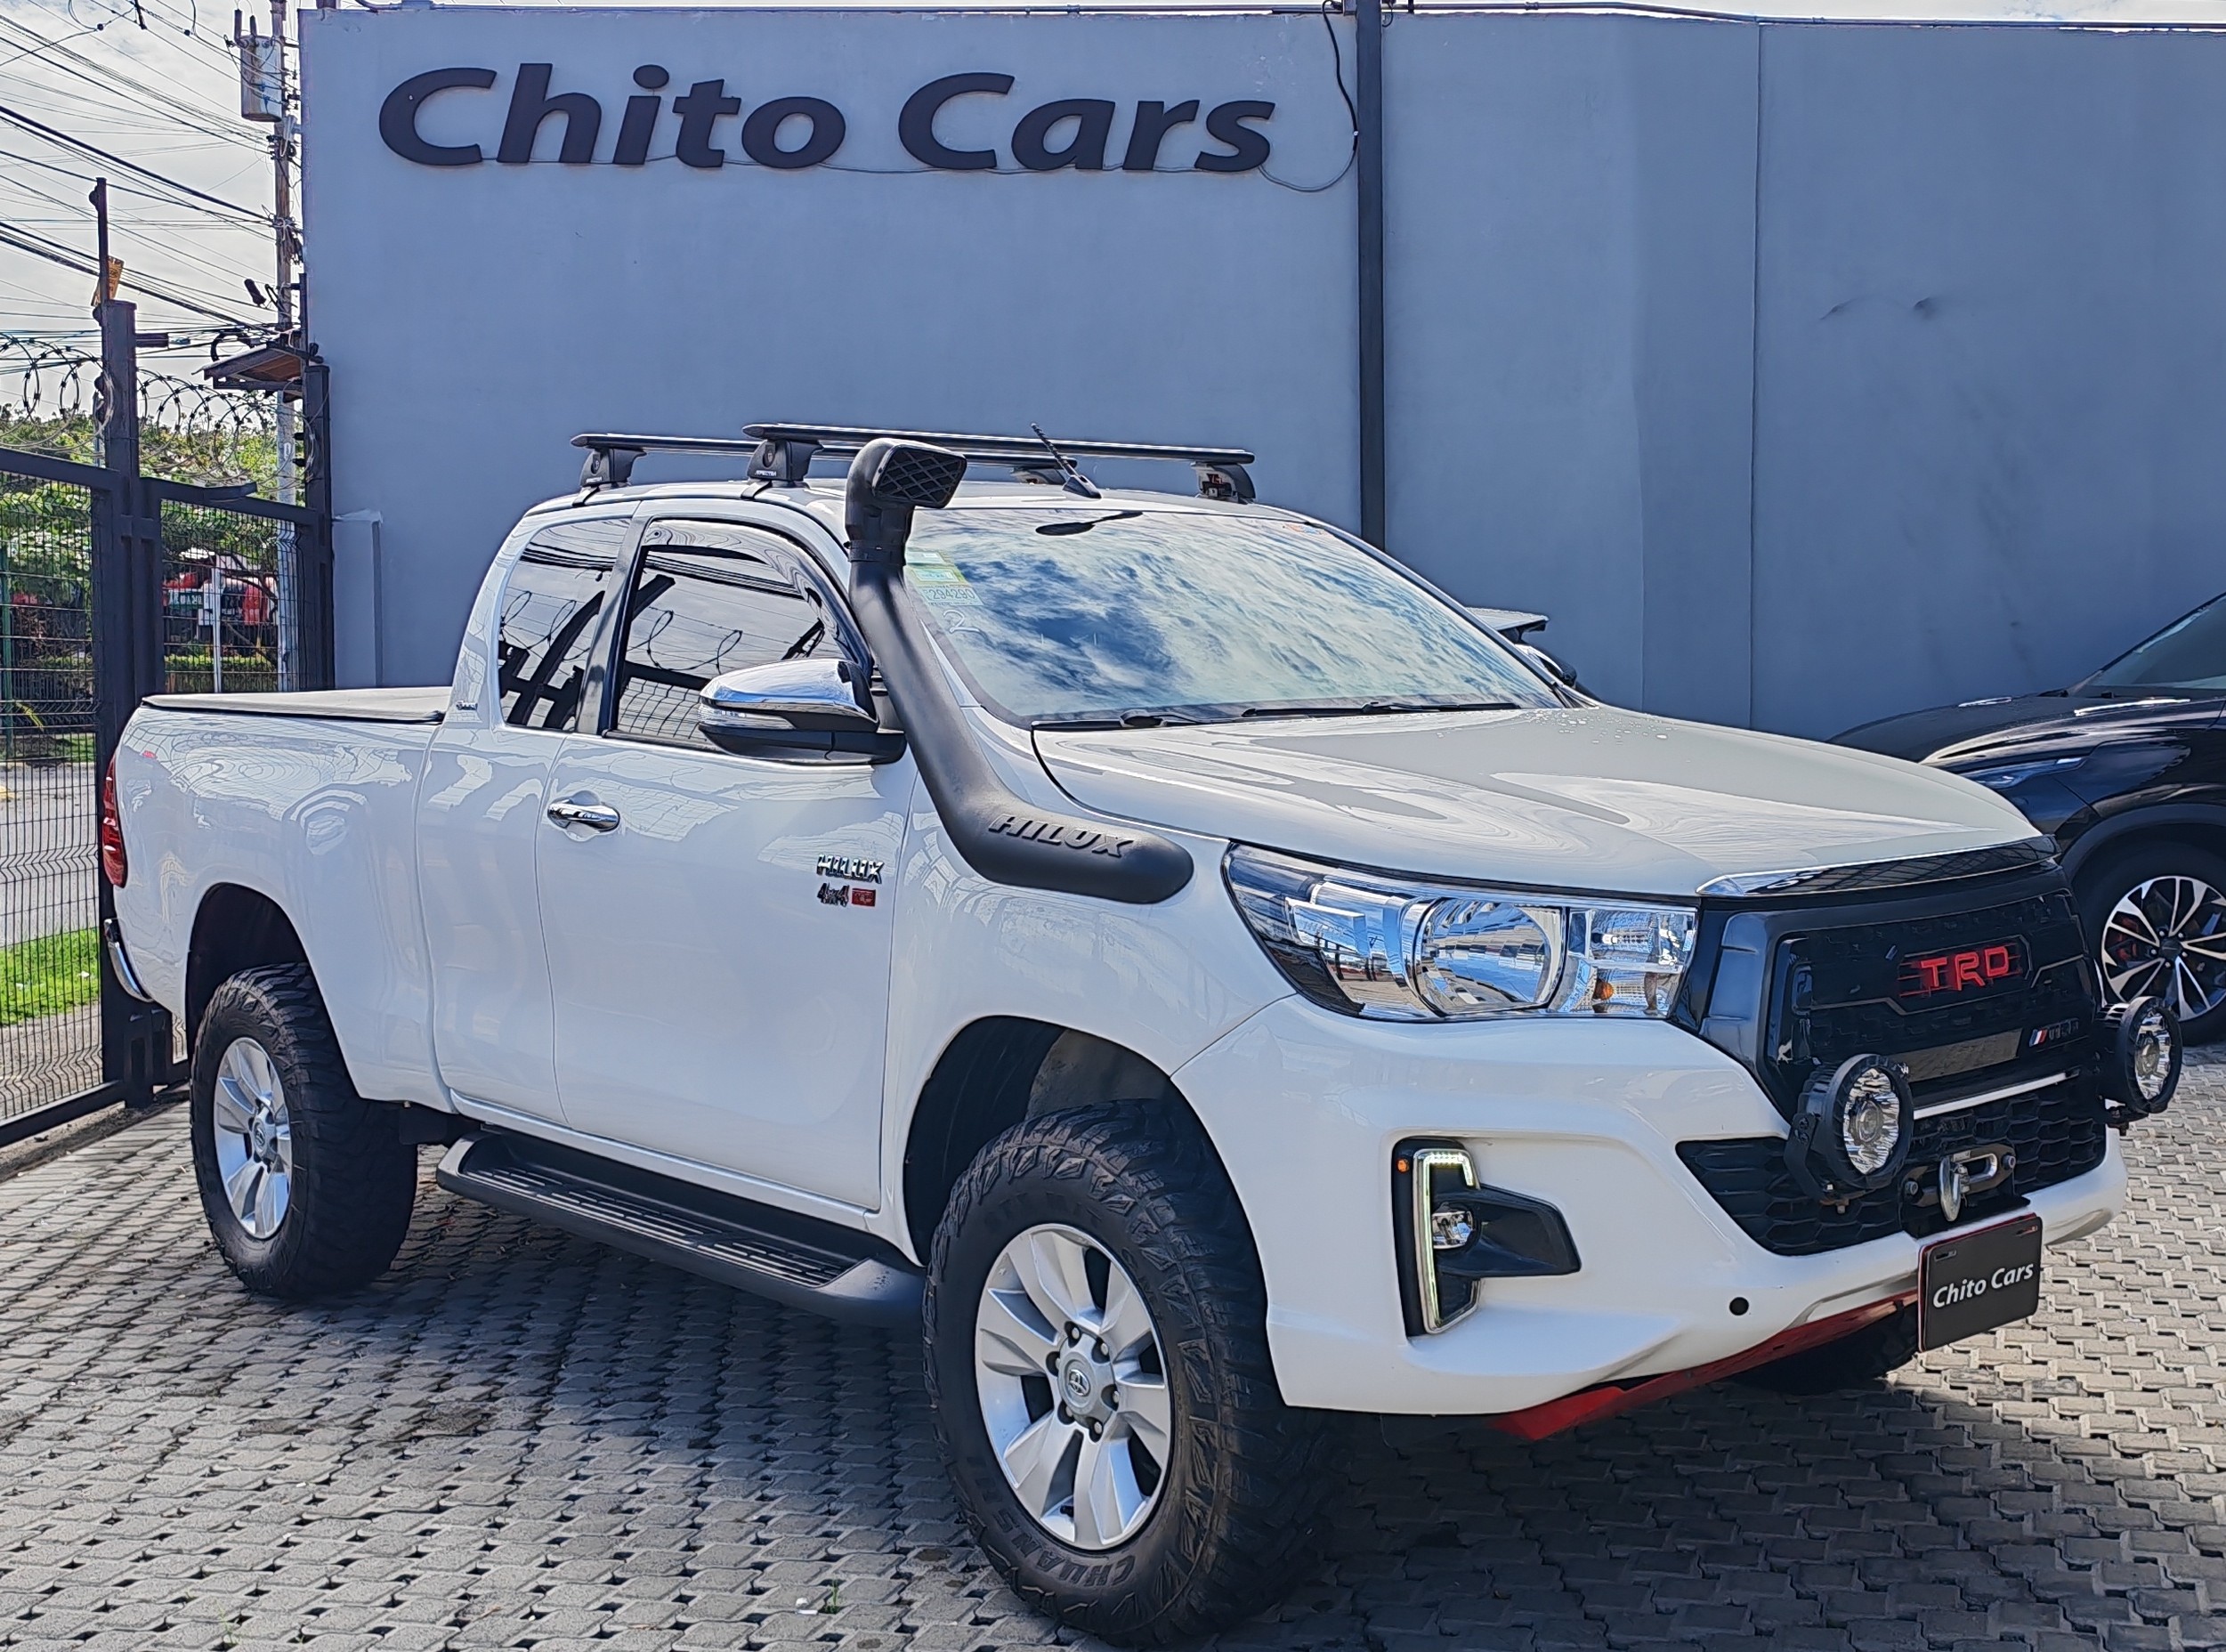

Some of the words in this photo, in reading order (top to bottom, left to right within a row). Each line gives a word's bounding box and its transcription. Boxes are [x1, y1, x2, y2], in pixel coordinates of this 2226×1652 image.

[379, 62, 846, 169] Chito
[898, 72, 1276, 173] Cars
[988, 813, 1135, 858] HILUX
[816, 854, 885, 885] HILUX
[1920, 945, 2011, 992] TRD
[1932, 1278, 1987, 1308] Chito
[1990, 1263, 2035, 1290] Cars
